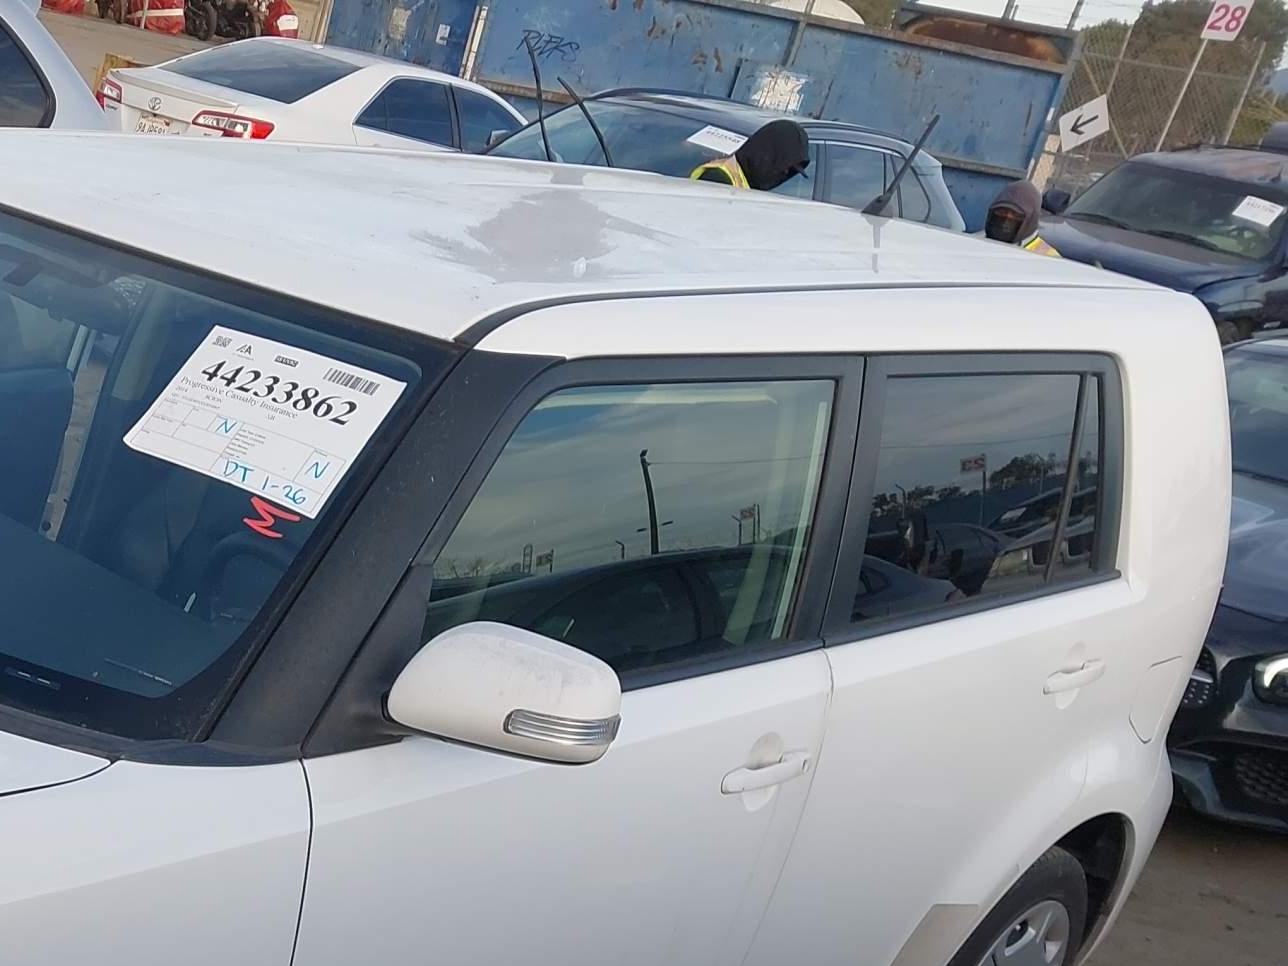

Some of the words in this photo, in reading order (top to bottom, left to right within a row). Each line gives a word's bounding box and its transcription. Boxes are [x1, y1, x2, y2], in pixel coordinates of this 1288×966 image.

[1207, 4, 1247, 33] 28
[181, 376, 225, 396] Progressive
[225, 390, 258, 406] Casualty
[260, 400, 298, 419] Insurance
[202, 360, 357, 425] 44233862
[215, 418, 238, 434] N
[304, 461, 330, 479] N
